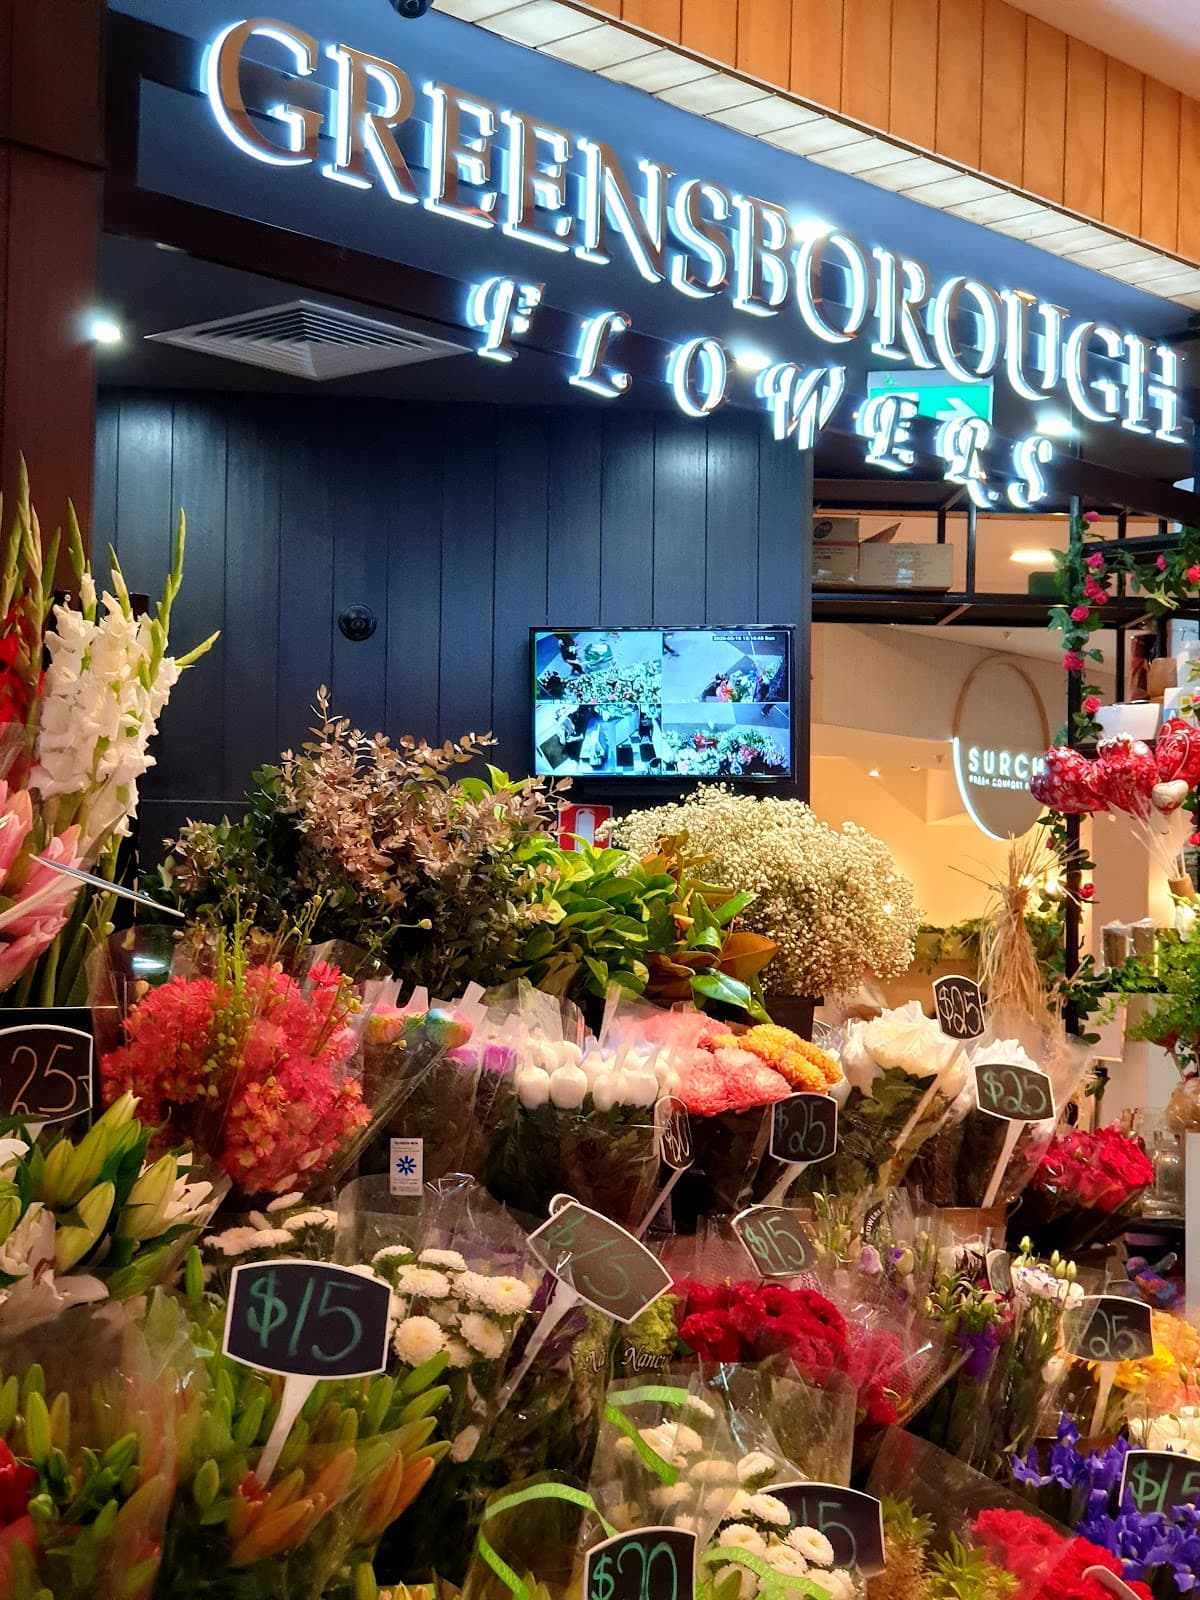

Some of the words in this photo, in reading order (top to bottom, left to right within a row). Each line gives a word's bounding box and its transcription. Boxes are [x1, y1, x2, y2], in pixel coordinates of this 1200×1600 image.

[206, 18, 1186, 443] GREENSBOROUGH
[466, 276, 1053, 508] FLOWERS
[938, 985, 981, 1035] $25
[8, 1044, 78, 1116] 25
[982, 1069, 1047, 1116] $25
[775, 1099, 827, 1156] $25
[744, 1216, 805, 1272] $15
[247, 1270, 363, 1363] $15
[790, 1496, 857, 1569] 15
